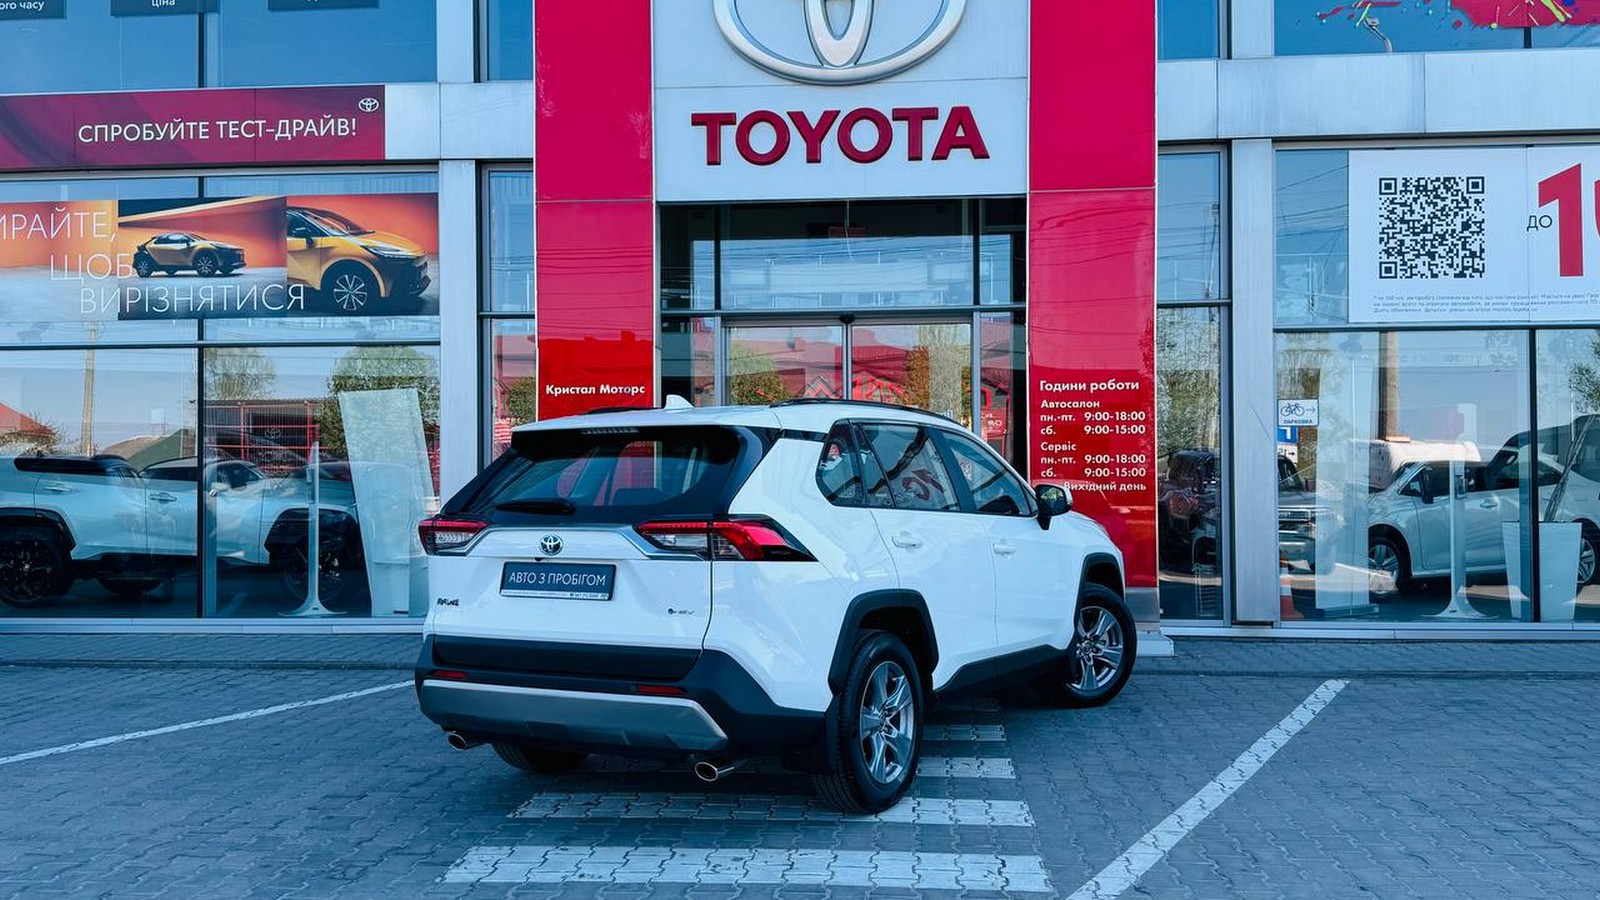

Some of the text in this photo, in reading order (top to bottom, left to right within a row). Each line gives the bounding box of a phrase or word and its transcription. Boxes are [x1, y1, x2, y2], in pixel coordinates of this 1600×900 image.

[20, 1, 44, 11] часу
[78, 114, 356, 143] СПРОБУЙТЕ ТЕСТ-ДРАЙВ!
[691, 106, 990, 166] TOYOTA
[1538, 162, 1600, 277] 1
[50, 253, 132, 284] ЩОБ
[80, 283, 305, 314] ВИРІЗНЯТИСЯ
[545, 384, 646, 397] Кристал Моторс
[1040, 378, 1140, 394] Години роботи
[1040, 399, 1100, 409] Автосалон
[1040, 411, 1146, 422] пн.-пт. 9:00-18:00
[1040, 424, 1146, 435] сб. 9:00-15:00
[1040, 441, 1077, 453] Сервіс
[1040, 454, 1146, 464] пн.-пт. 9:00-18:00
[1040, 467, 1146, 477] сб. 9:00-15:00
[1064, 481, 1147, 492] Вихідний день
[509, 572, 537, 584] АВТО
[547, 573, 606, 586] ПРОБІГОМ
